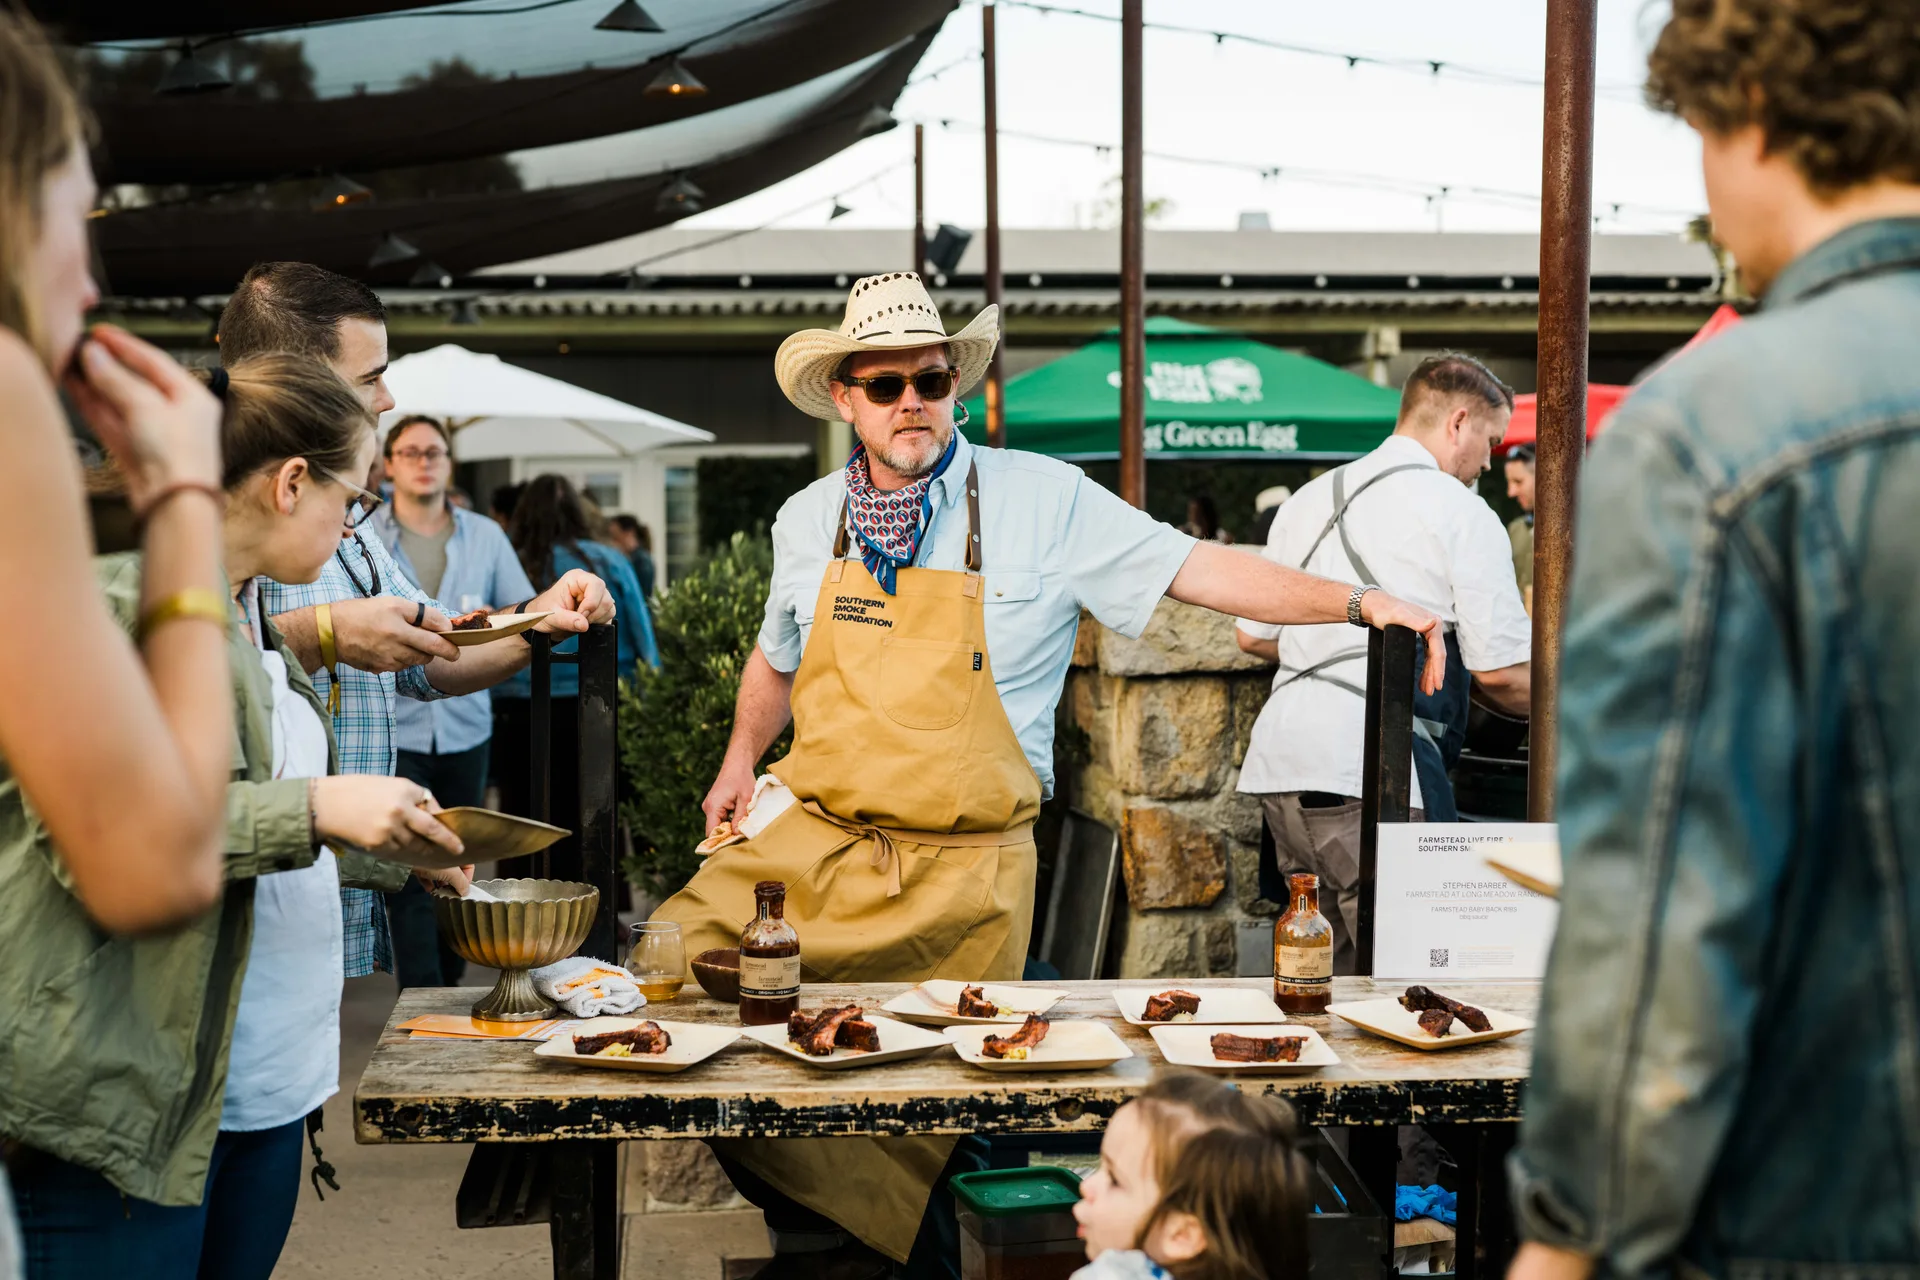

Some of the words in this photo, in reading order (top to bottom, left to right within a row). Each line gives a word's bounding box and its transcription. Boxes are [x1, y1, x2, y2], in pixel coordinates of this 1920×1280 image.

[1165, 421, 1245, 447] Green
[1247, 421, 1298, 452] Egg
[834, 596, 885, 609] SOUTHERN
[833, 605, 866, 615] SMOKE
[832, 613, 893, 628] FOUNDATION
[1418, 836, 1465, 844] FARMSTEAD
[1467, 836, 1484, 844] LIVE
